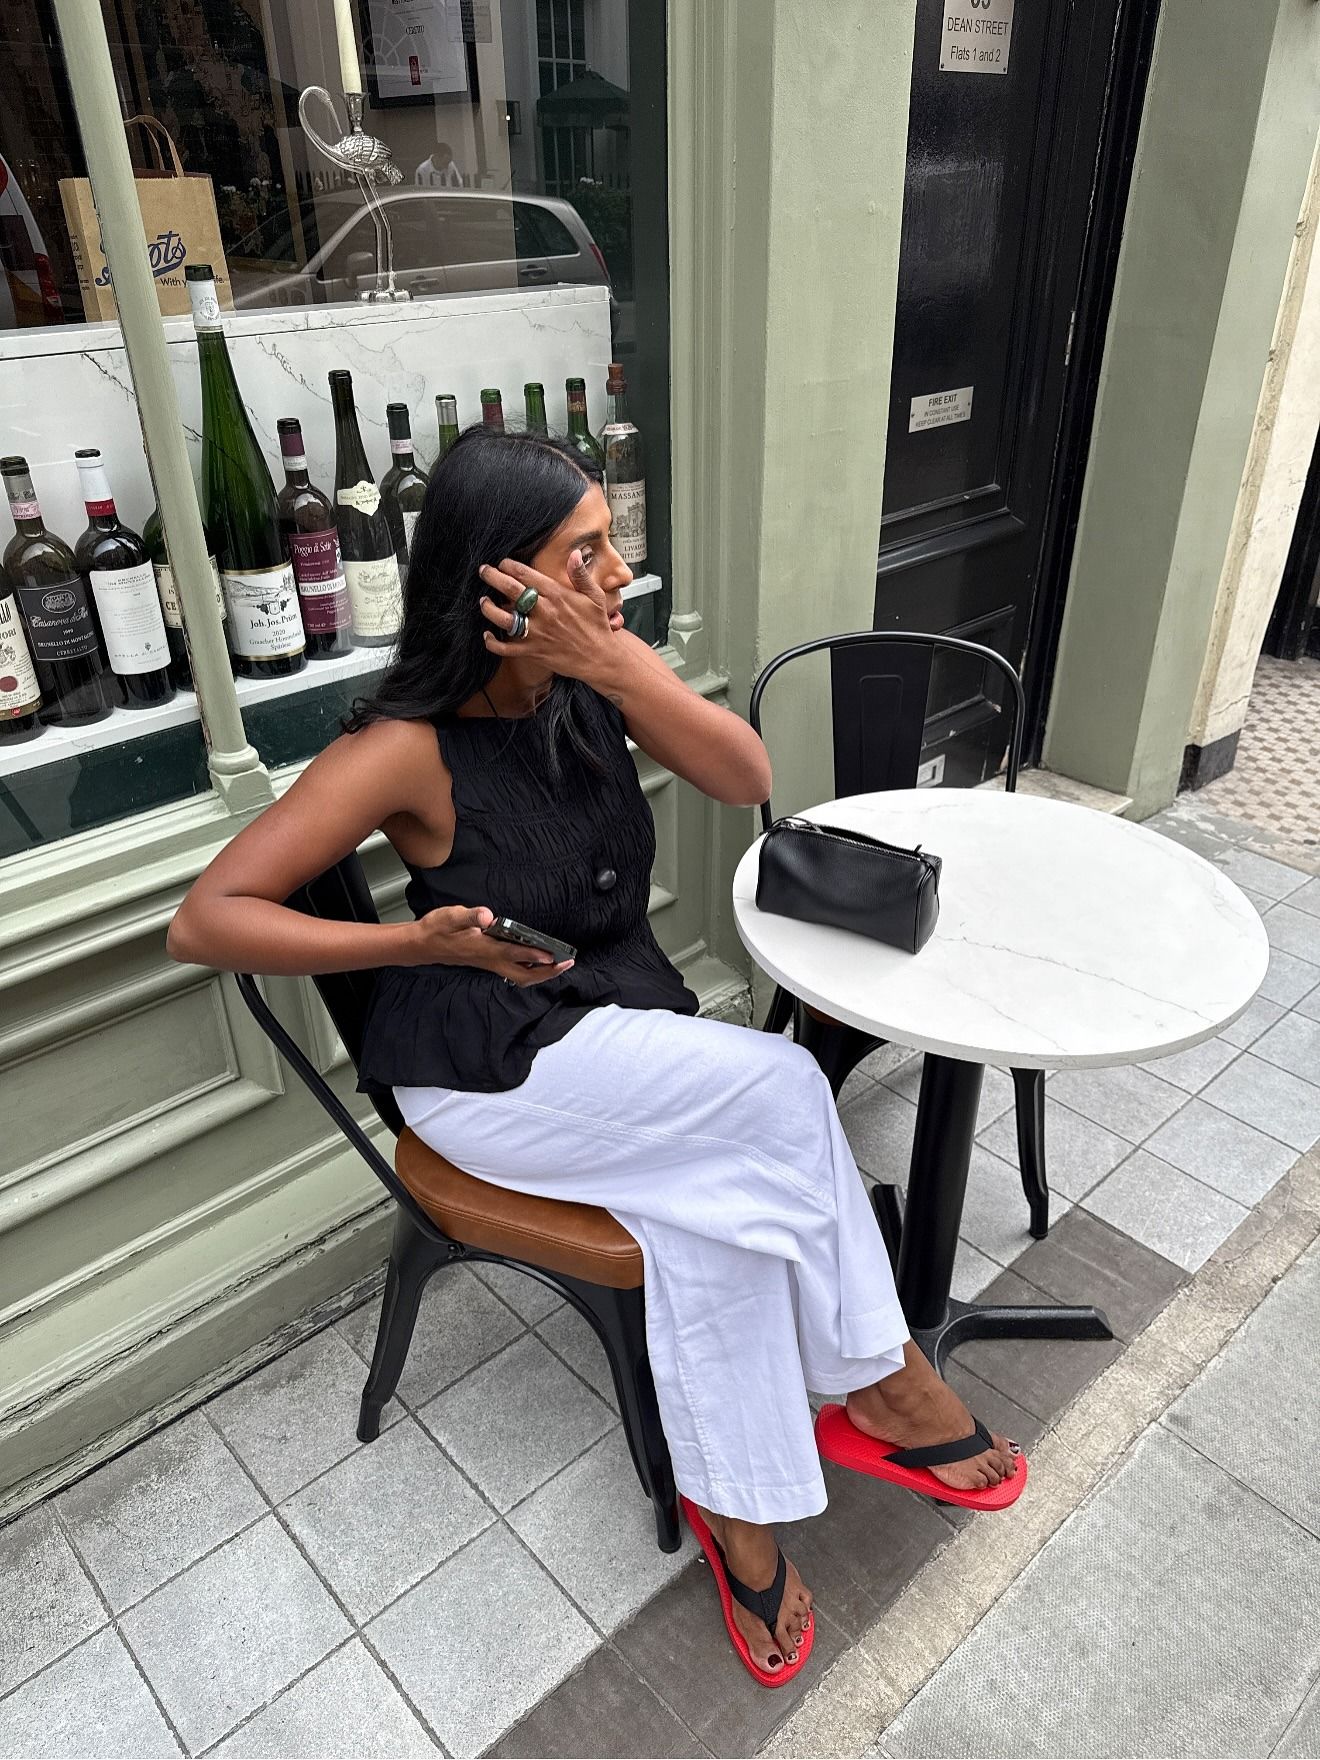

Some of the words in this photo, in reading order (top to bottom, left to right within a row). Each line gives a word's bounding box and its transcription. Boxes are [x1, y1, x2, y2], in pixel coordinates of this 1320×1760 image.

[947, 17, 972, 32] DEAN
[974, 20, 1009, 36] STREET
[950, 46, 970, 60] Flats
[972, 48, 977, 61] 1
[979, 49, 994, 62] and
[994, 49, 1001, 62] 2
[160, 276, 180, 287] With
[928, 396, 944, 407] FIRE
[944, 394, 958, 404] EXIT
[294, 543, 312, 558] Poggio
[250, 619, 267, 630] Joh.
[267, 618, 281, 629] Jos.
